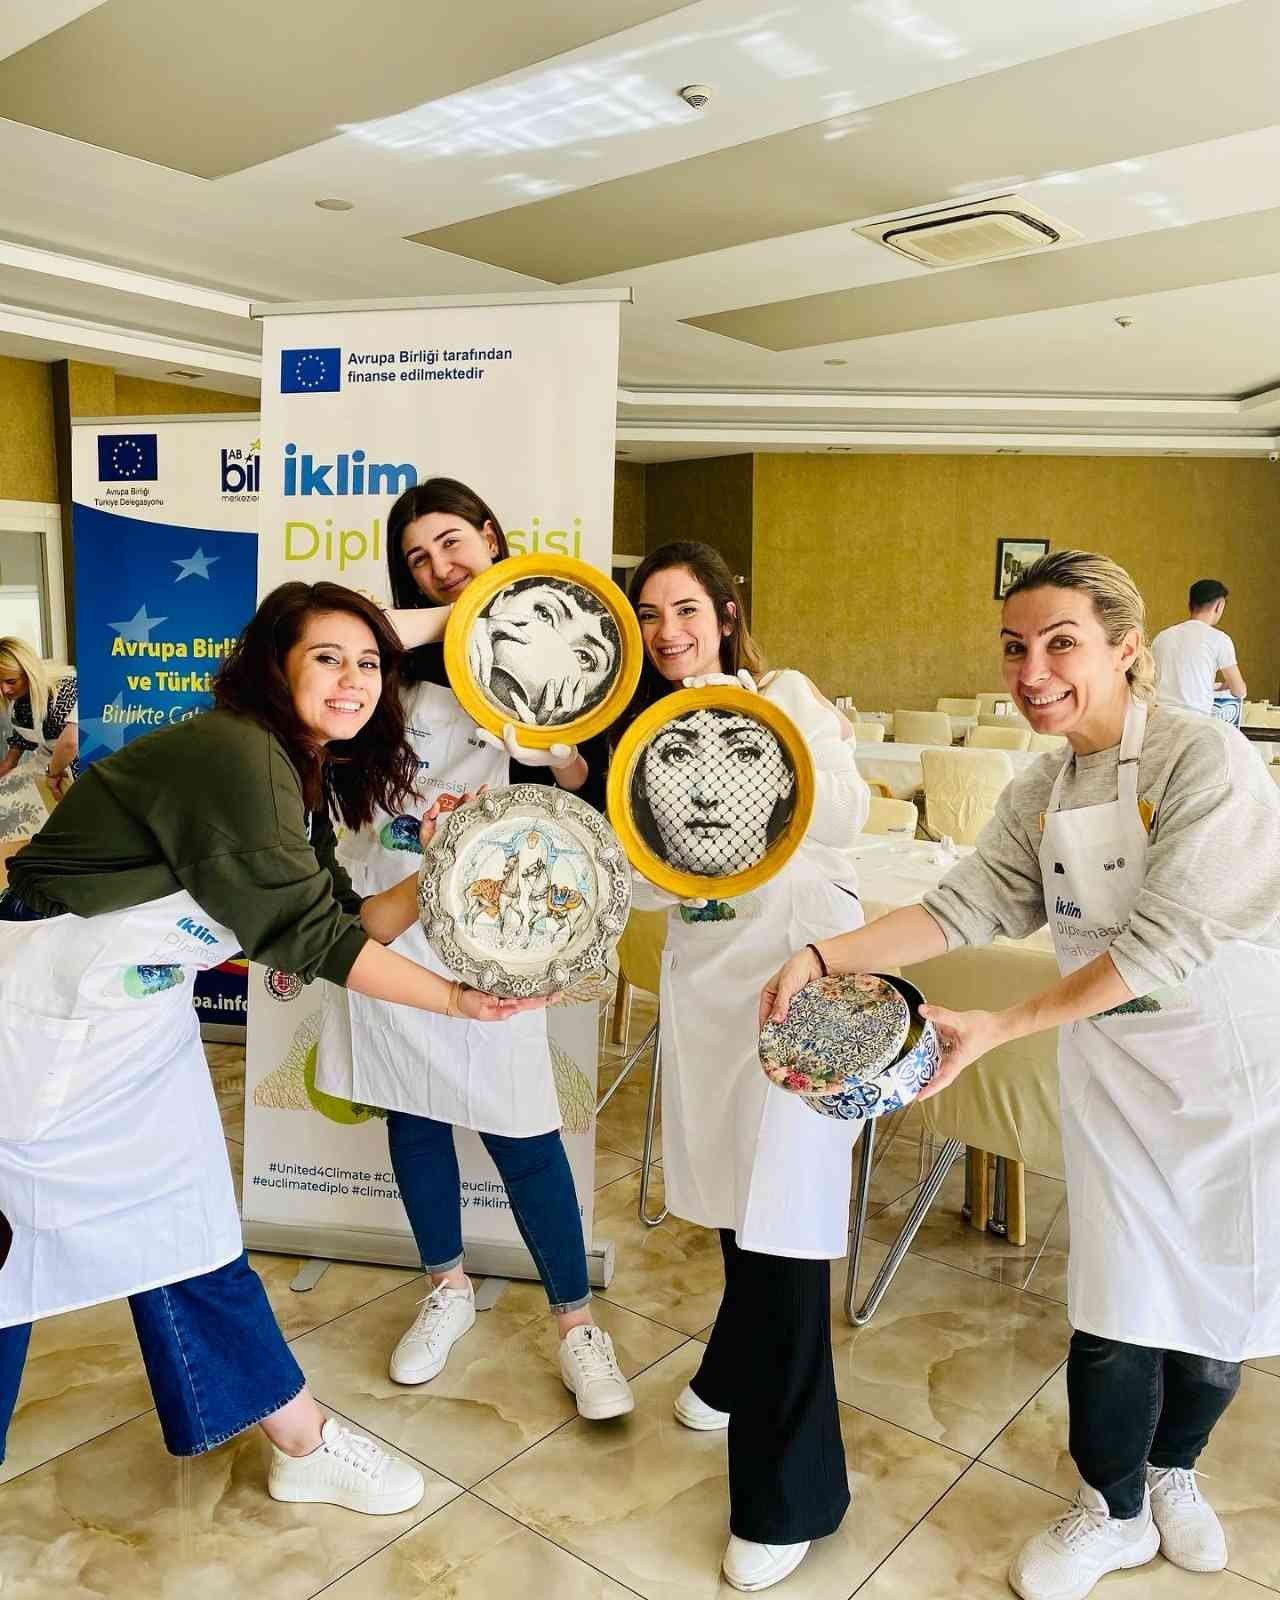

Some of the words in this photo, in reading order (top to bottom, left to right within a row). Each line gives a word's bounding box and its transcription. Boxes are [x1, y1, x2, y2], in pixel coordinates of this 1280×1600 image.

[347, 351, 395, 365] Avrupa
[400, 349, 439, 365] Birliği
[443, 348, 513, 362] tarafından
[347, 370, 396, 383] finanse
[400, 367, 484, 381] edilmektedir
[228, 449, 242, 459] AB
[221, 449, 260, 492] bil
[106, 488, 129, 497] Avrupa
[95, 498, 118, 507] Türkiye
[119, 498, 164, 507] Delegasyonu
[112, 637, 188, 661] Avrupa
[193, 638, 243, 659] Birli
[127, 675, 151, 691] ve
[155, 671, 214, 692] Türki
[102, 704, 165, 724] Birlikte
[192, 994, 248, 1012] pa.info
[268, 1162, 371, 1182] #United4Climate
[253, 1175, 349, 1194] #euclimatediplo
